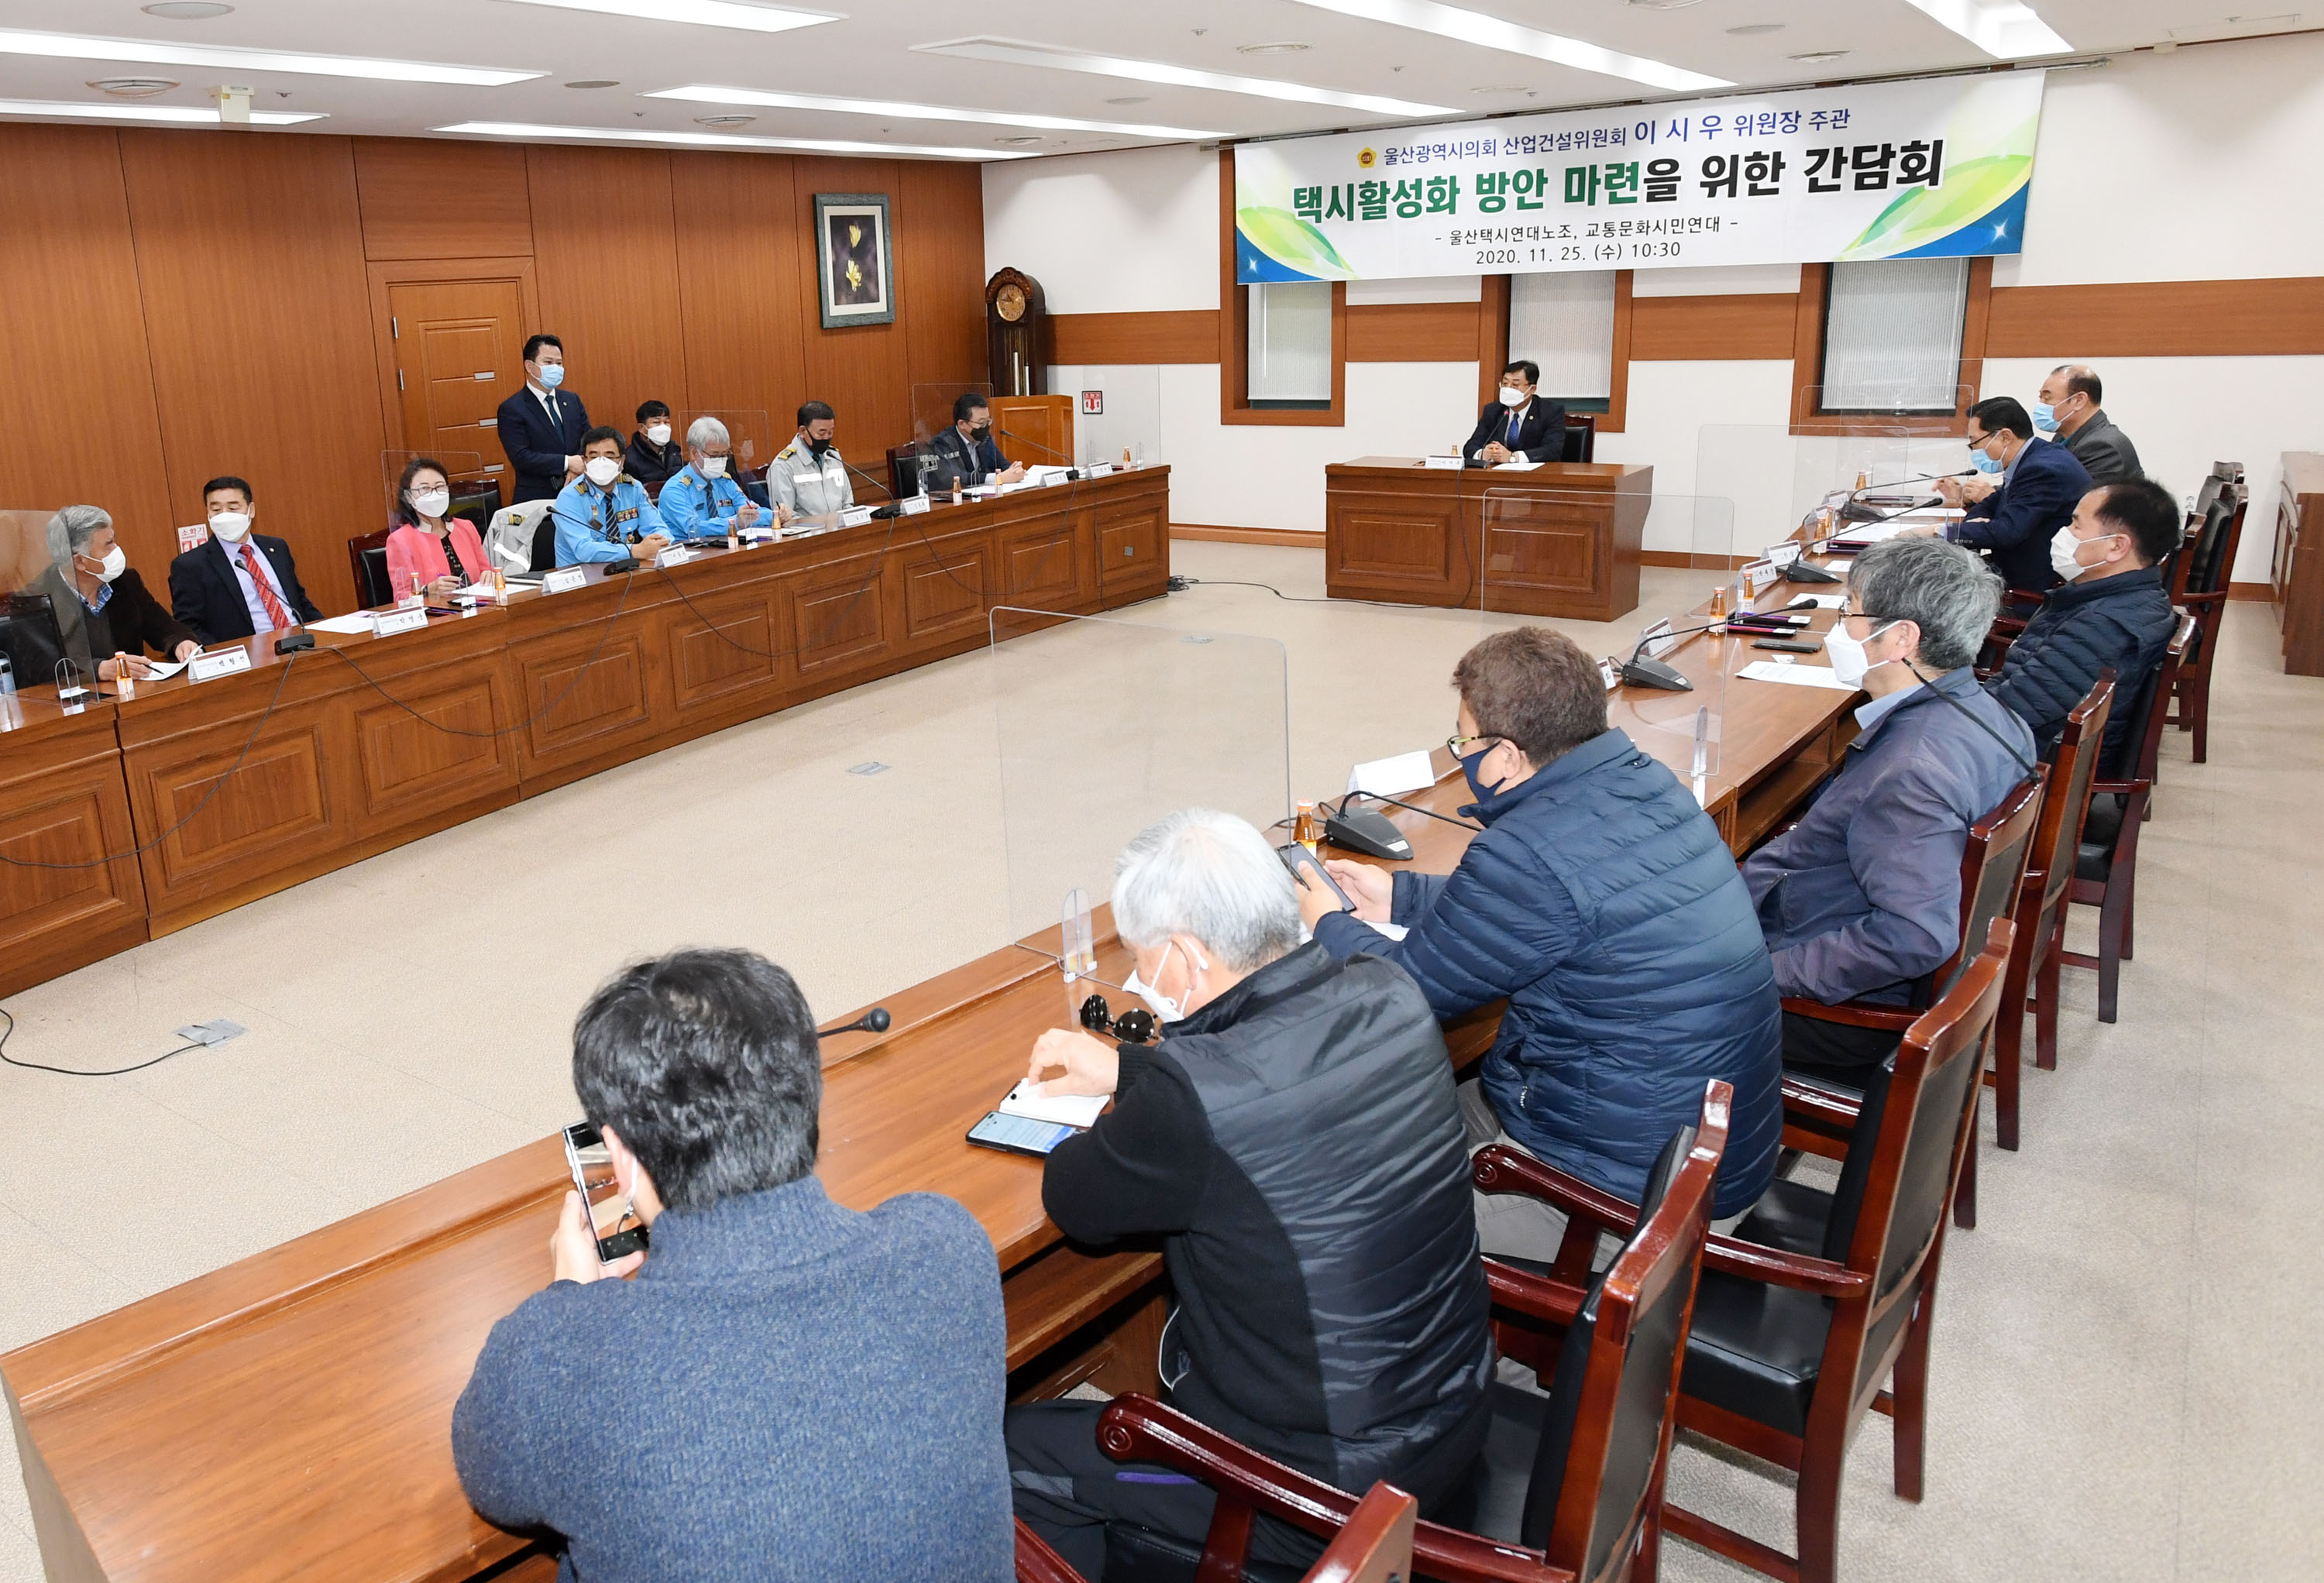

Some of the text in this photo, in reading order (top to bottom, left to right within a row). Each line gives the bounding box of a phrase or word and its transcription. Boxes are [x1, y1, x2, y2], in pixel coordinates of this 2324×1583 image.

[1384, 139, 1497, 166] 울산광역시의회
[1504, 127, 1627, 156] 산업건설위원회
[1733, 110, 1802, 137] 위원장
[1808, 108, 1851, 132] 주관
[1294, 139, 1944, 224] 택시활성화 방안 마련을 위한 간담회
[1449, 224, 1577, 246] 울산택시연대노조,
[1585, 216, 1720, 239] 교통문화시민연대
[1476, 242, 1680, 265] 2020. 11. 25. (수) 10:30
[180, 527, 205, 536] 소화기
